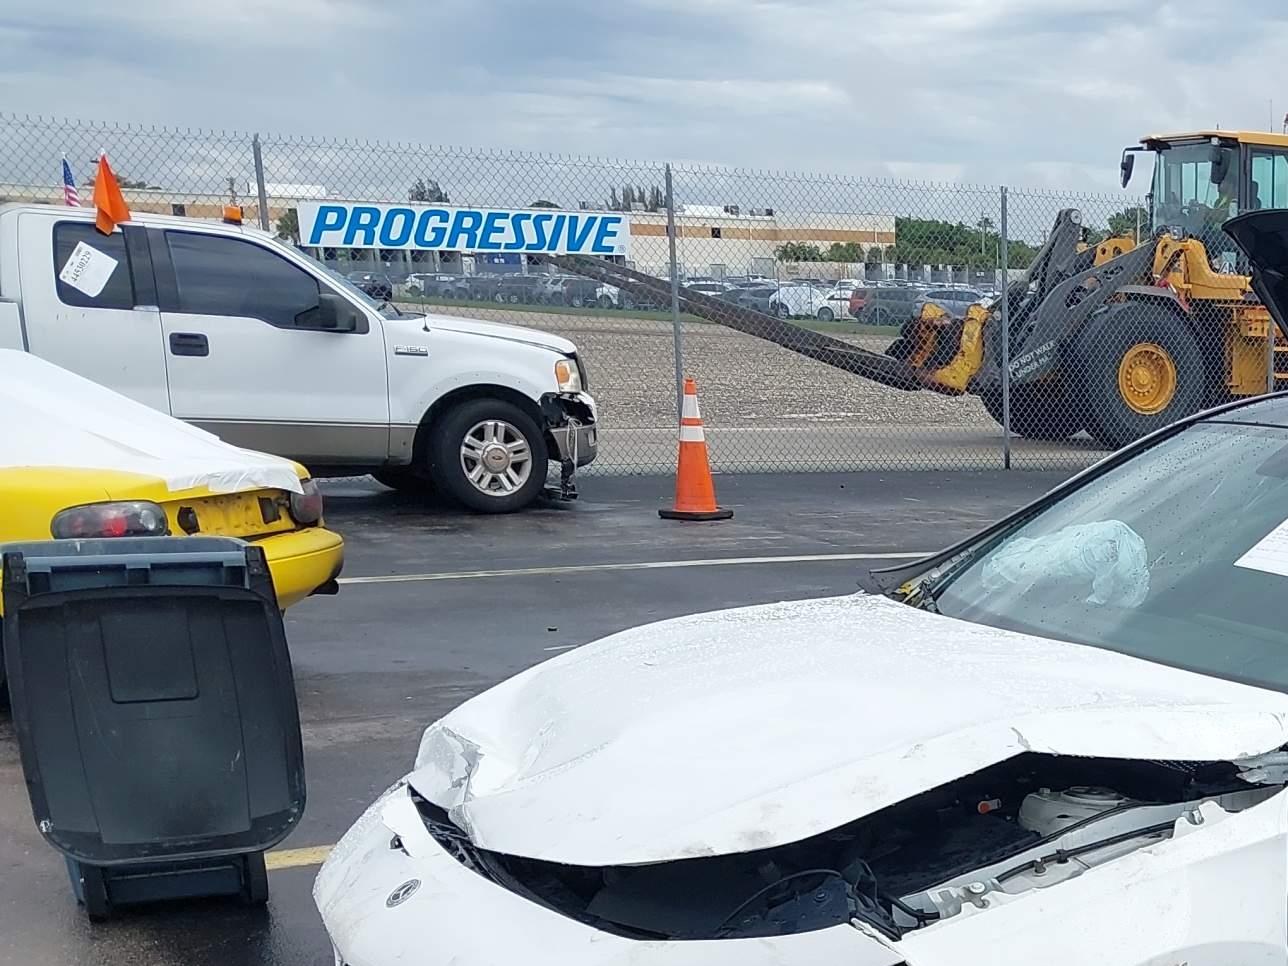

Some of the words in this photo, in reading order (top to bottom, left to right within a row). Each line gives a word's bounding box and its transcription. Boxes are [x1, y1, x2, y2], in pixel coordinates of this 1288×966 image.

[309, 205, 621, 252] PROGRESSIVE
[1009, 360, 1020, 371] DO
[1020, 352, 1034, 365] NOT
